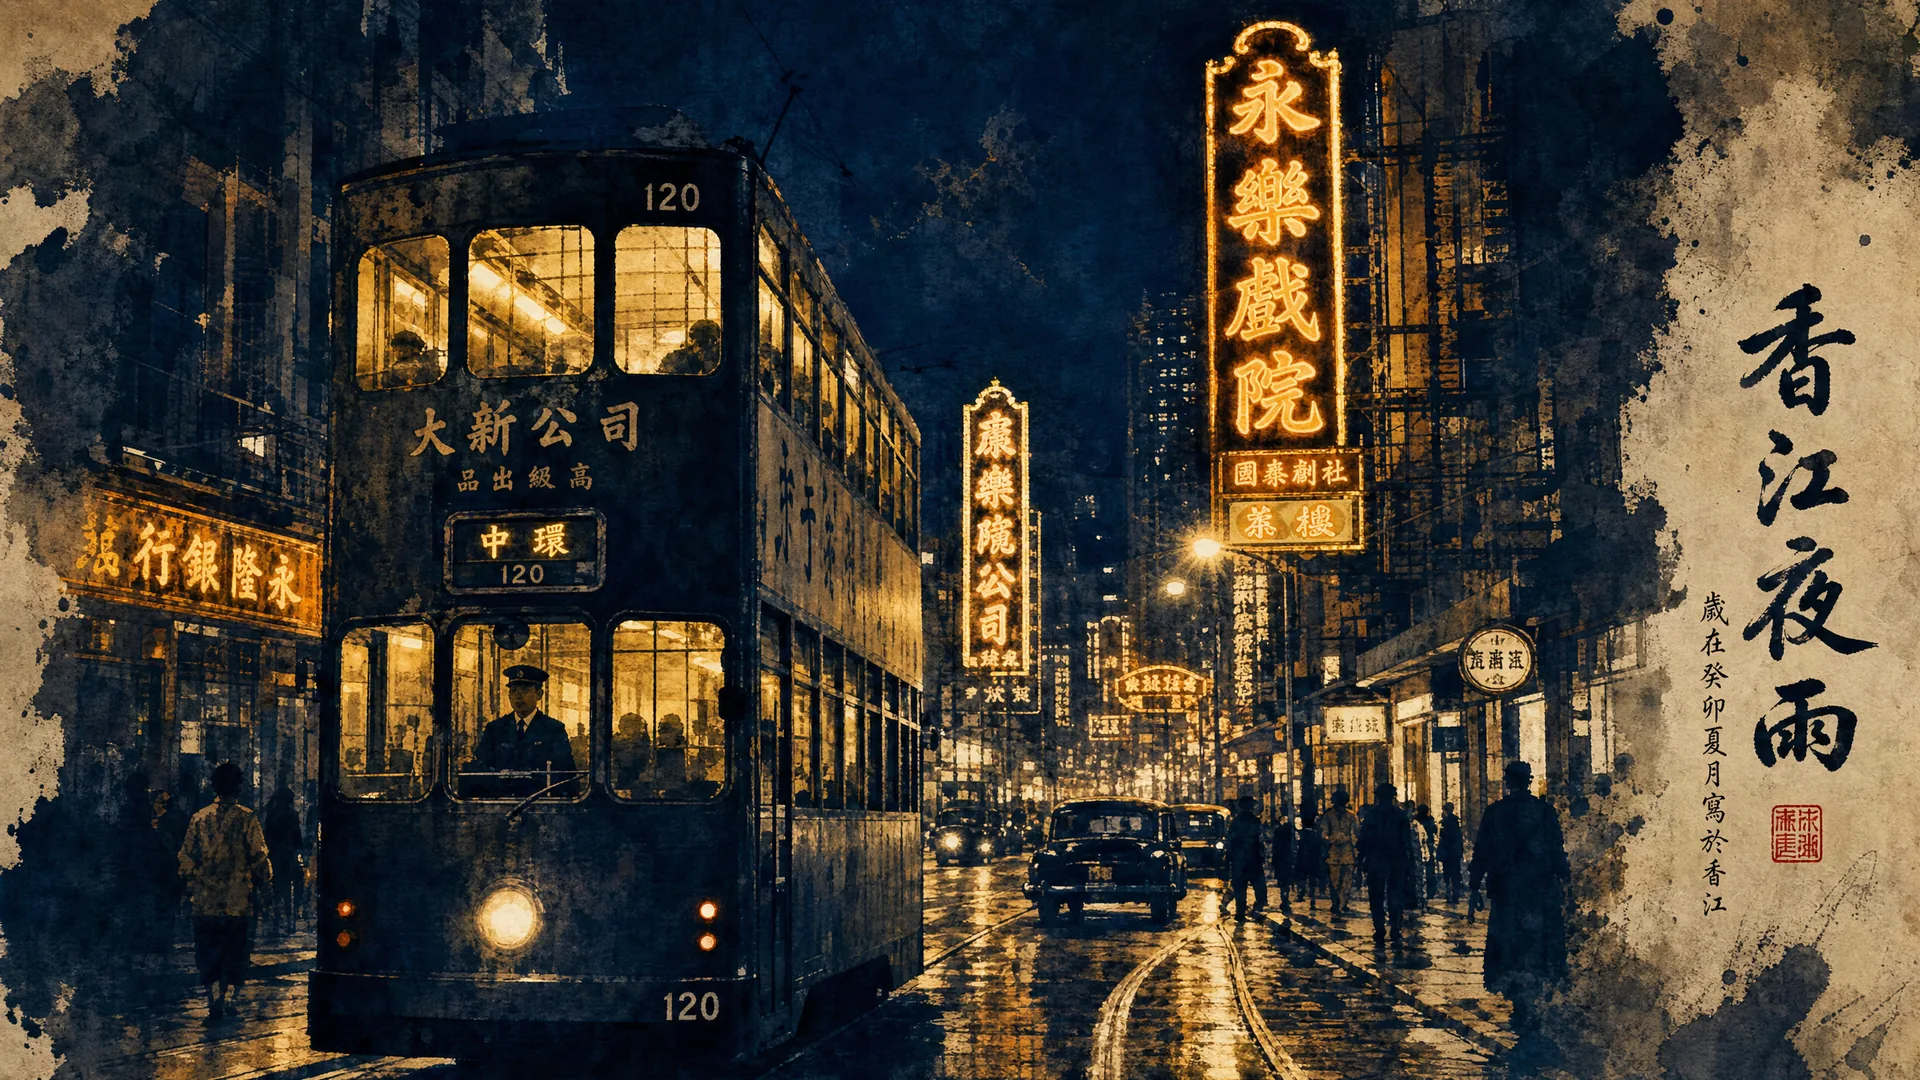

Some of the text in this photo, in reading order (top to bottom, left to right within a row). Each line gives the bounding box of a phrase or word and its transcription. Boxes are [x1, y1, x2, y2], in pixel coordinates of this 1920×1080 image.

[644, 182, 700, 212] 120
[1228, 59, 1323, 435] 永樂戲院
[409, 399, 639, 457] 大新公司
[480, 524, 569, 559] 中環
[500, 564, 544, 584] 120
[663, 991, 720, 1021] 120
